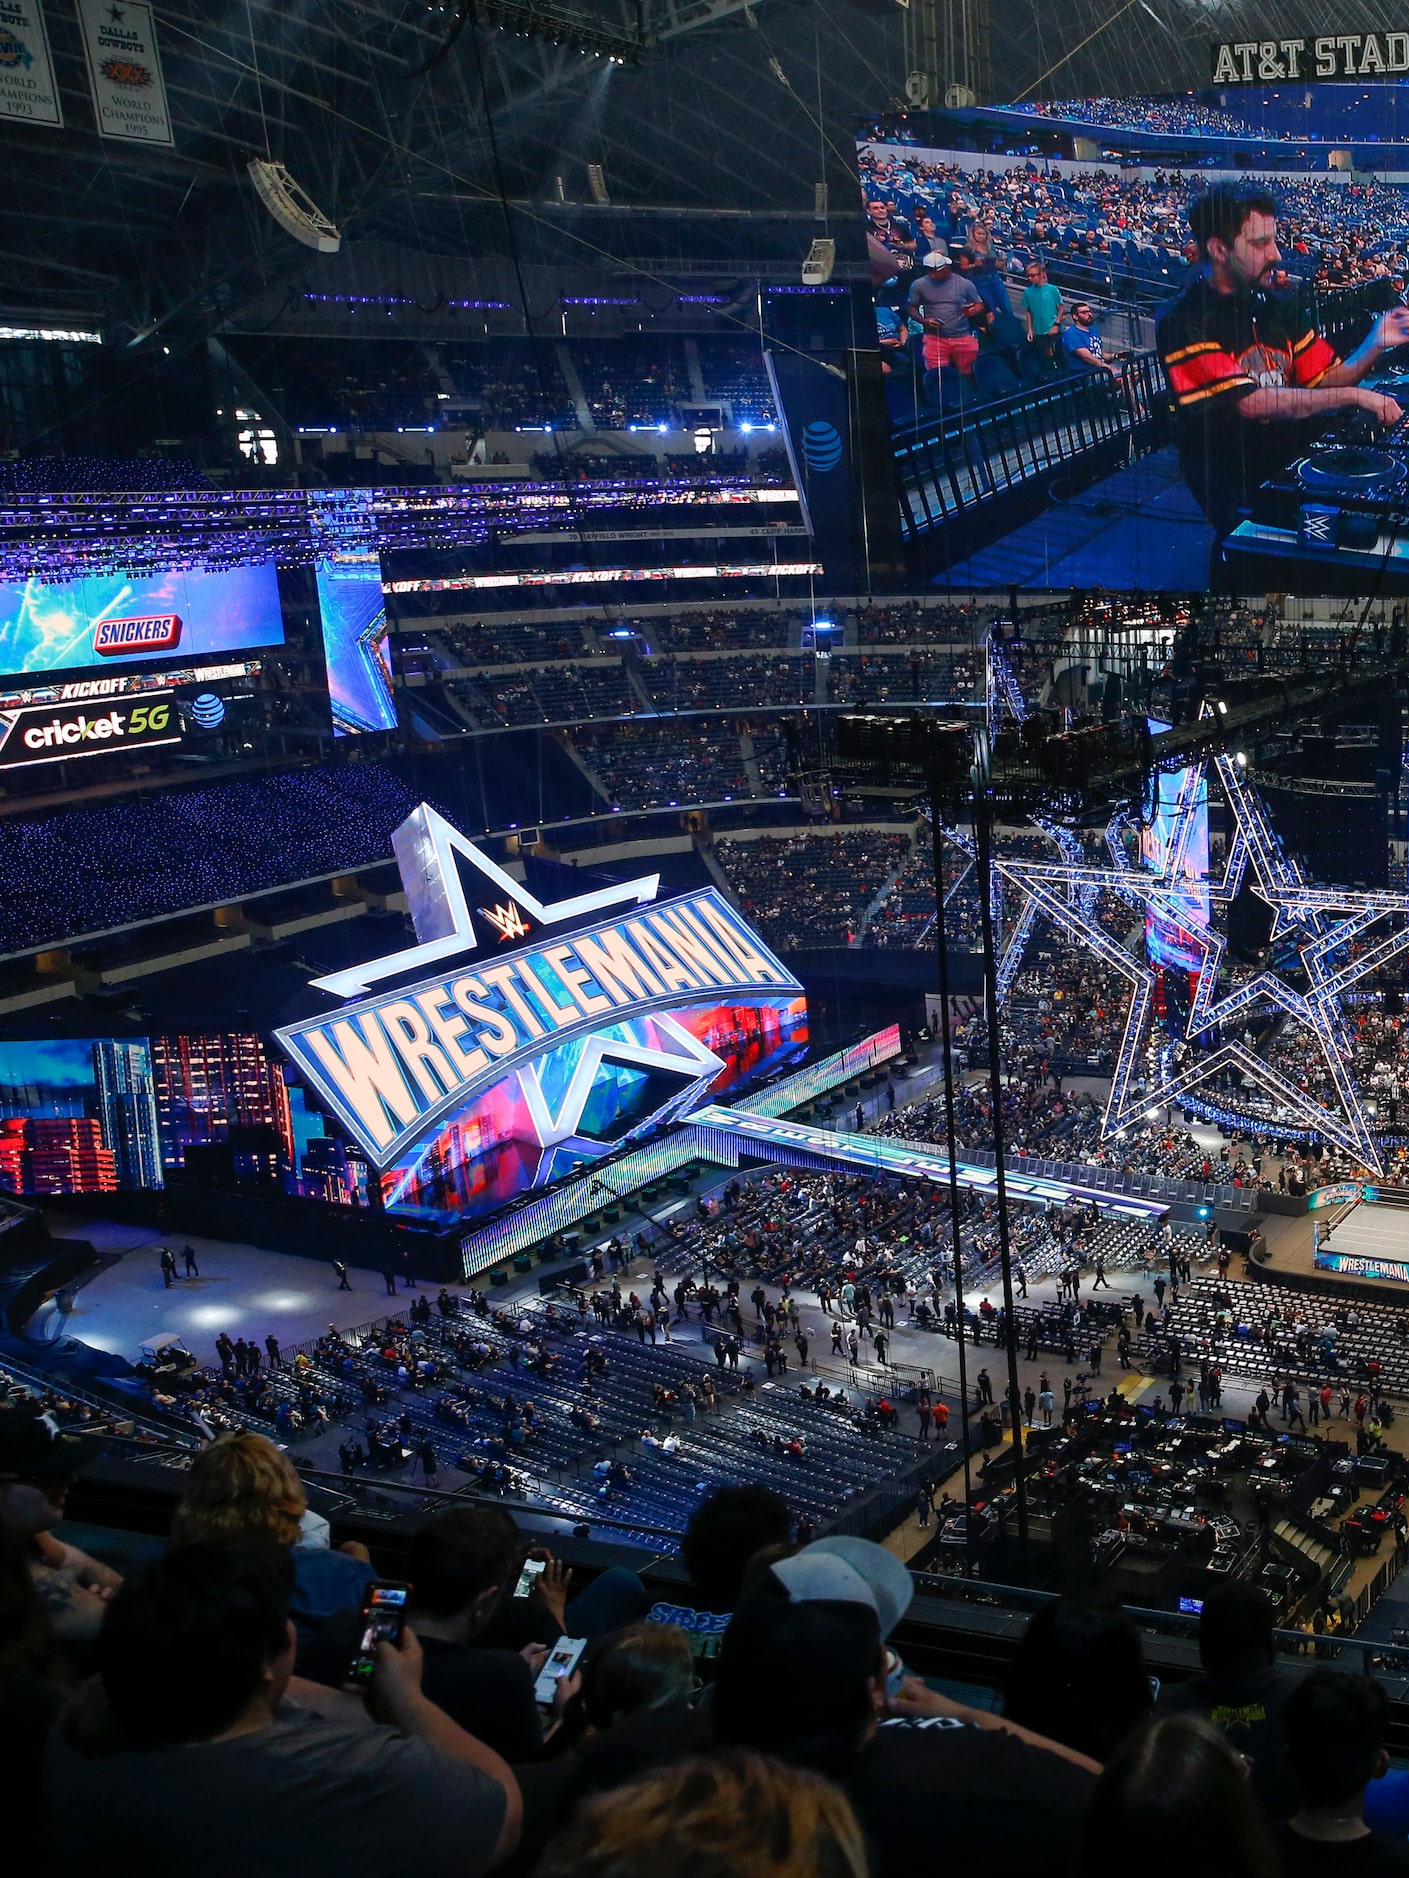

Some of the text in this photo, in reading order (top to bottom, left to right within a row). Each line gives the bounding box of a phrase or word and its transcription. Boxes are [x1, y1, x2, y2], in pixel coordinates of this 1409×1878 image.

[100, 25, 138, 41] DALLAS
[98, 37, 145, 53] COWBOYS
[1213, 39, 1304, 83] AT&T
[7, 101, 32, 114] 1993
[111, 96, 151, 111] WORLD
[102, 107, 165, 126] CHAMPIONS
[125, 123, 148, 135] 1995
[618, 531, 648, 539] WRIGHT
[571, 570, 623, 583] KICKOFF
[768, 564, 816, 576] KICKOFF
[99, 619, 170, 645] SNICKERS
[60, 677, 128, 699] KICKOFF
[24, 705, 169, 749] cricket 5G
[305, 900, 787, 1148] WRESTLEMANIA
[1339, 1256, 1409, 1282] WRESTLEMANIA
